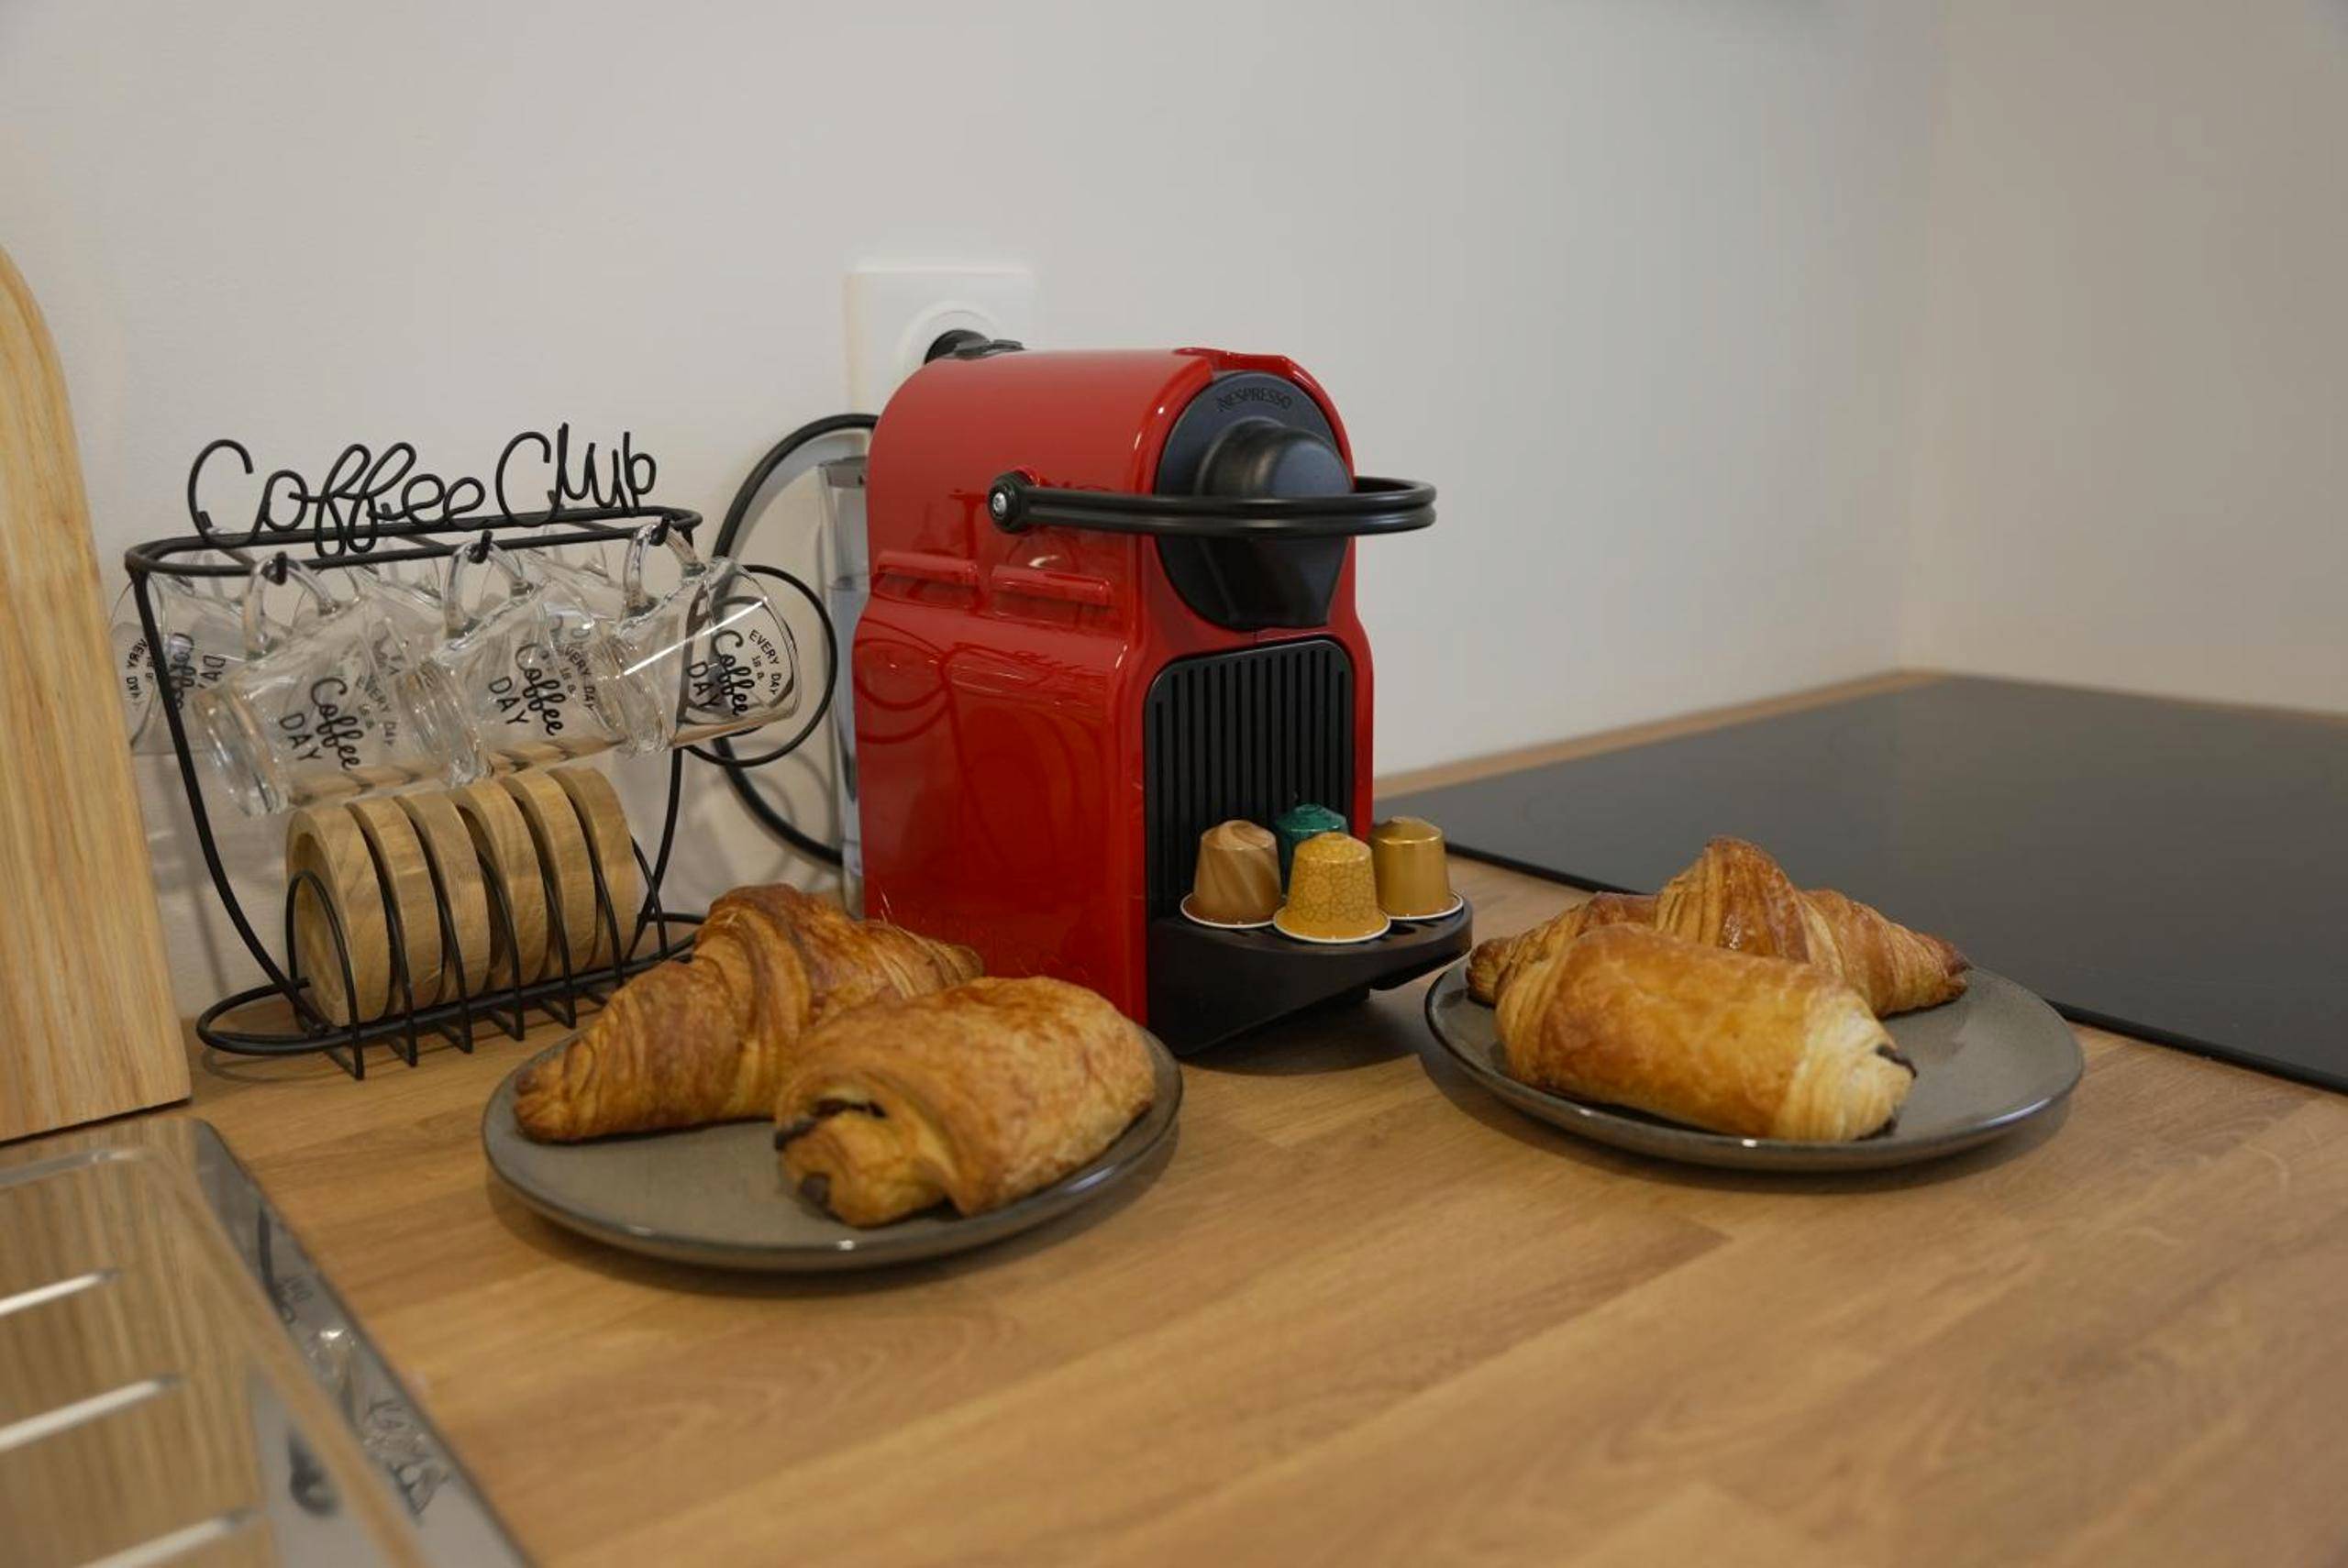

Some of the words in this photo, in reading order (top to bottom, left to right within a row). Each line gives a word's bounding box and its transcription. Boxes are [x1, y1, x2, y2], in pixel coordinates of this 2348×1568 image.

[1218, 387, 1292, 412] NESPRESSO
[188, 438, 485, 558] Coffee
[495, 422, 657, 527] Club
[515, 643, 566, 736] Coffee
[688, 661, 721, 707] DAY
[713, 629, 755, 716] Coffee
[749, 629, 780, 665] EVERY
[770, 673, 782, 695] DAY
[311, 677, 364, 771] Coffee
[488, 676, 530, 724] DAY
[279, 712, 323, 761] DAY
